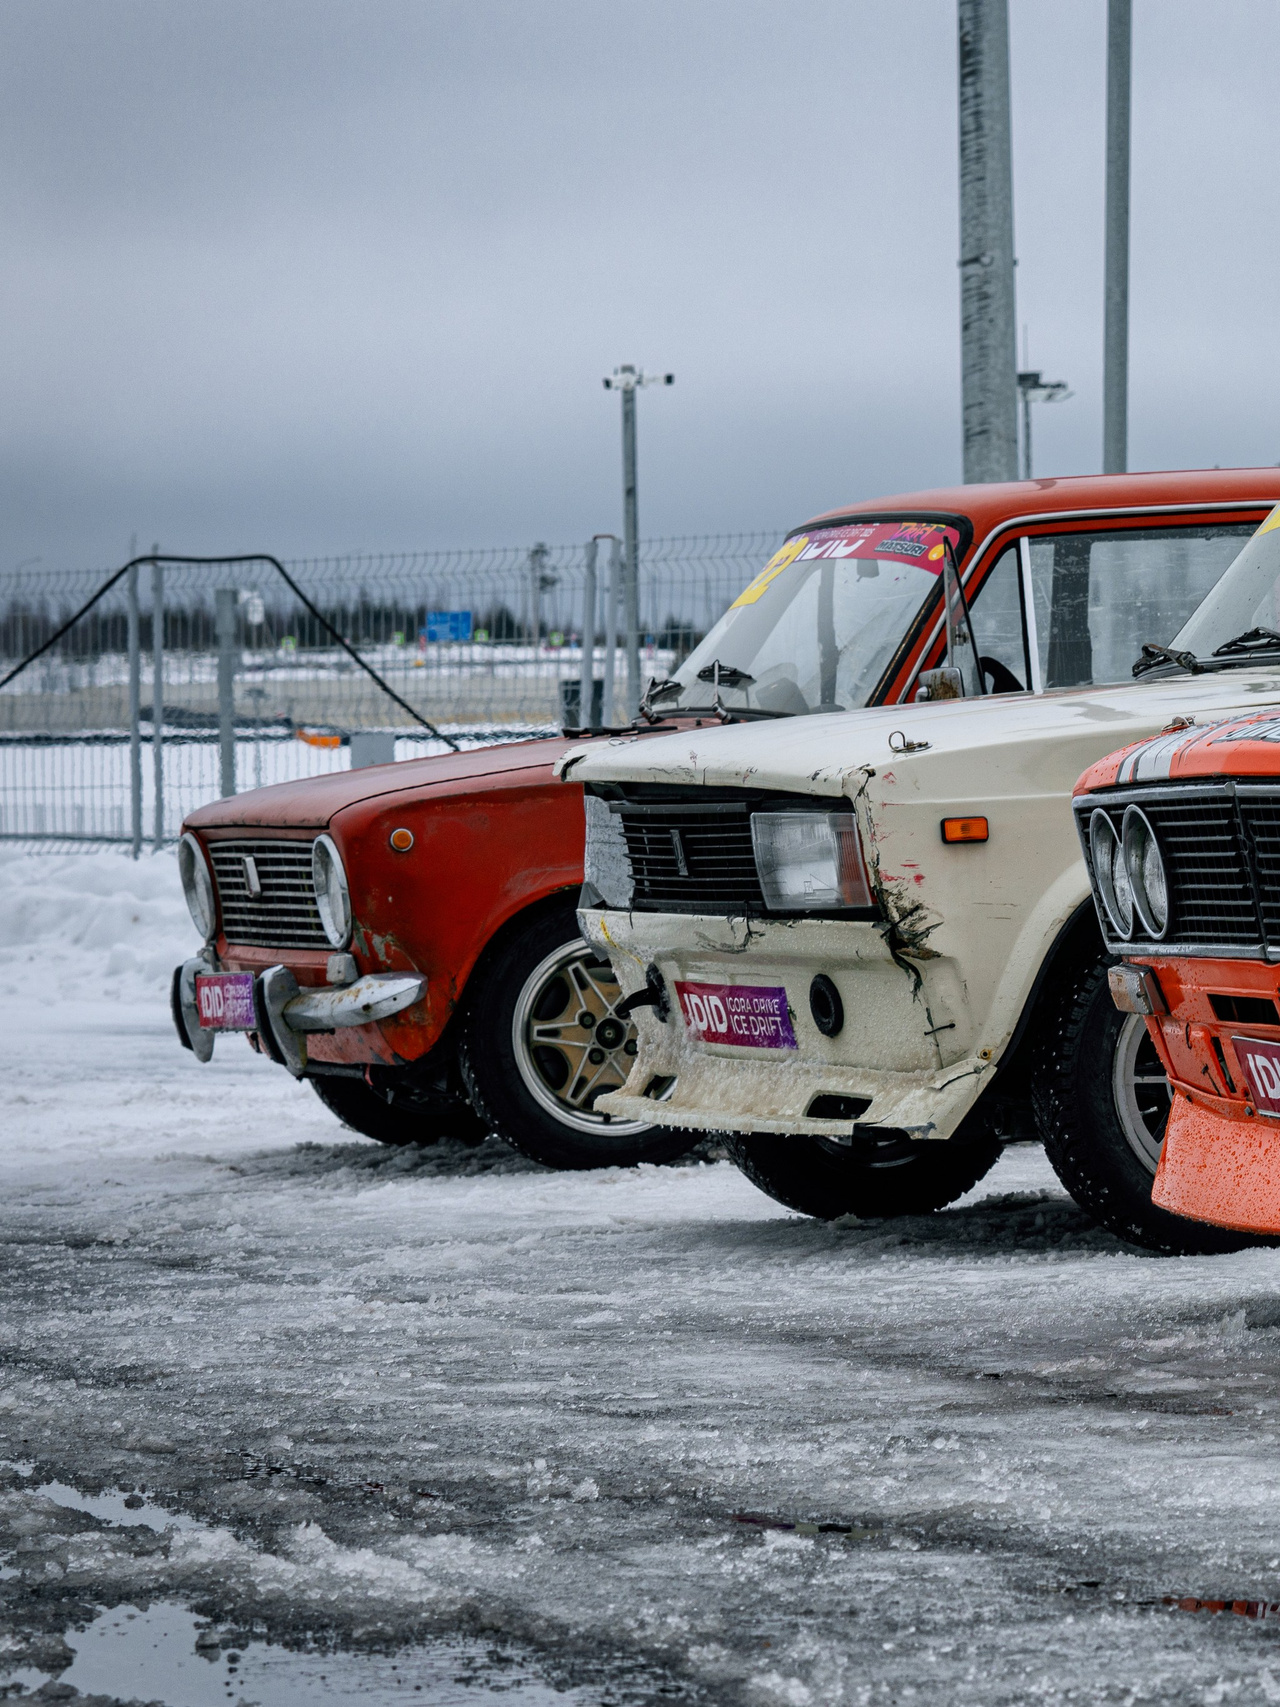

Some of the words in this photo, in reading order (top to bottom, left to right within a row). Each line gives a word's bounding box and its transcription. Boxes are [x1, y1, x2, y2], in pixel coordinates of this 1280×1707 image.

[874, 539, 929, 557] MATSURI
[683, 992, 728, 1033] IDID
[726, 997, 753, 1013] IGORA
[752, 998, 781, 1015] DRIVE
[729, 1014, 751, 1035] ICE
[749, 1016, 784, 1037] DRIFT
